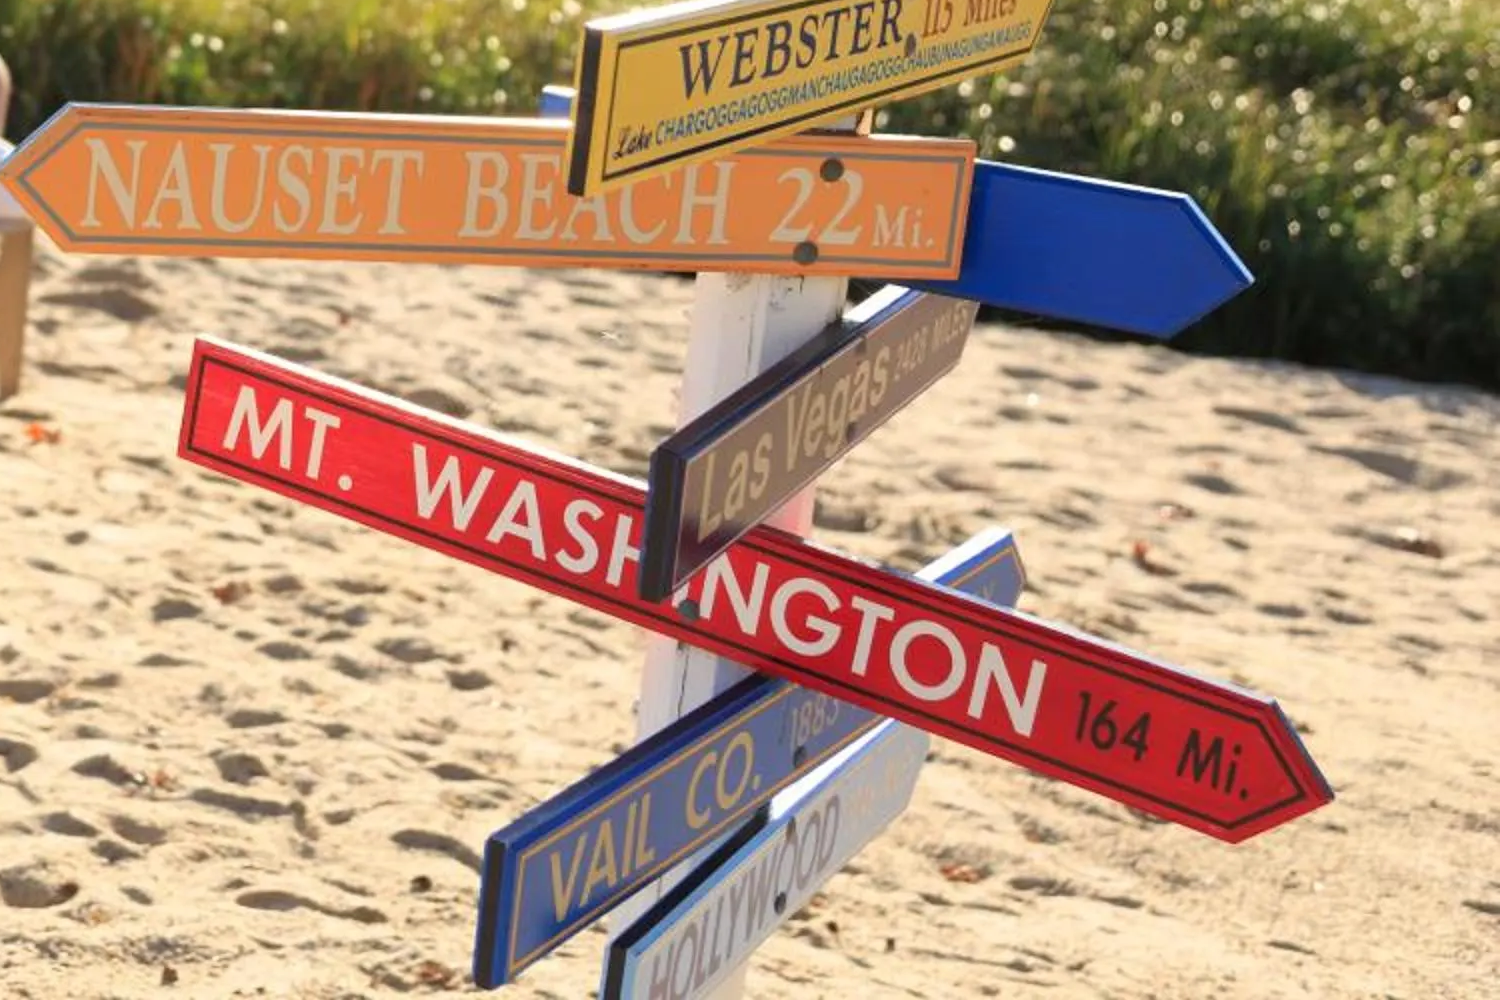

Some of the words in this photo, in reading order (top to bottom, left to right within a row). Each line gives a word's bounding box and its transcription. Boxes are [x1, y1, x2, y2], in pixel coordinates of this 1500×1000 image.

[80, 138, 425, 237] NAUSET
[767, 165, 865, 246] 22
[870, 202, 935, 250] Mi.
[611, 121, 652, 160] Lake
[697, 431, 774, 543] Las
[785, 345, 891, 473] Vegas
[222, 384, 354, 492] MT.
[411, 442, 1047, 738] WASHNGTON
[1074, 691, 1150, 762] 164
[1177, 728, 1249, 800] Mi.
[550, 793, 656, 922] VAIL
[684, 731, 763, 830] CO.
